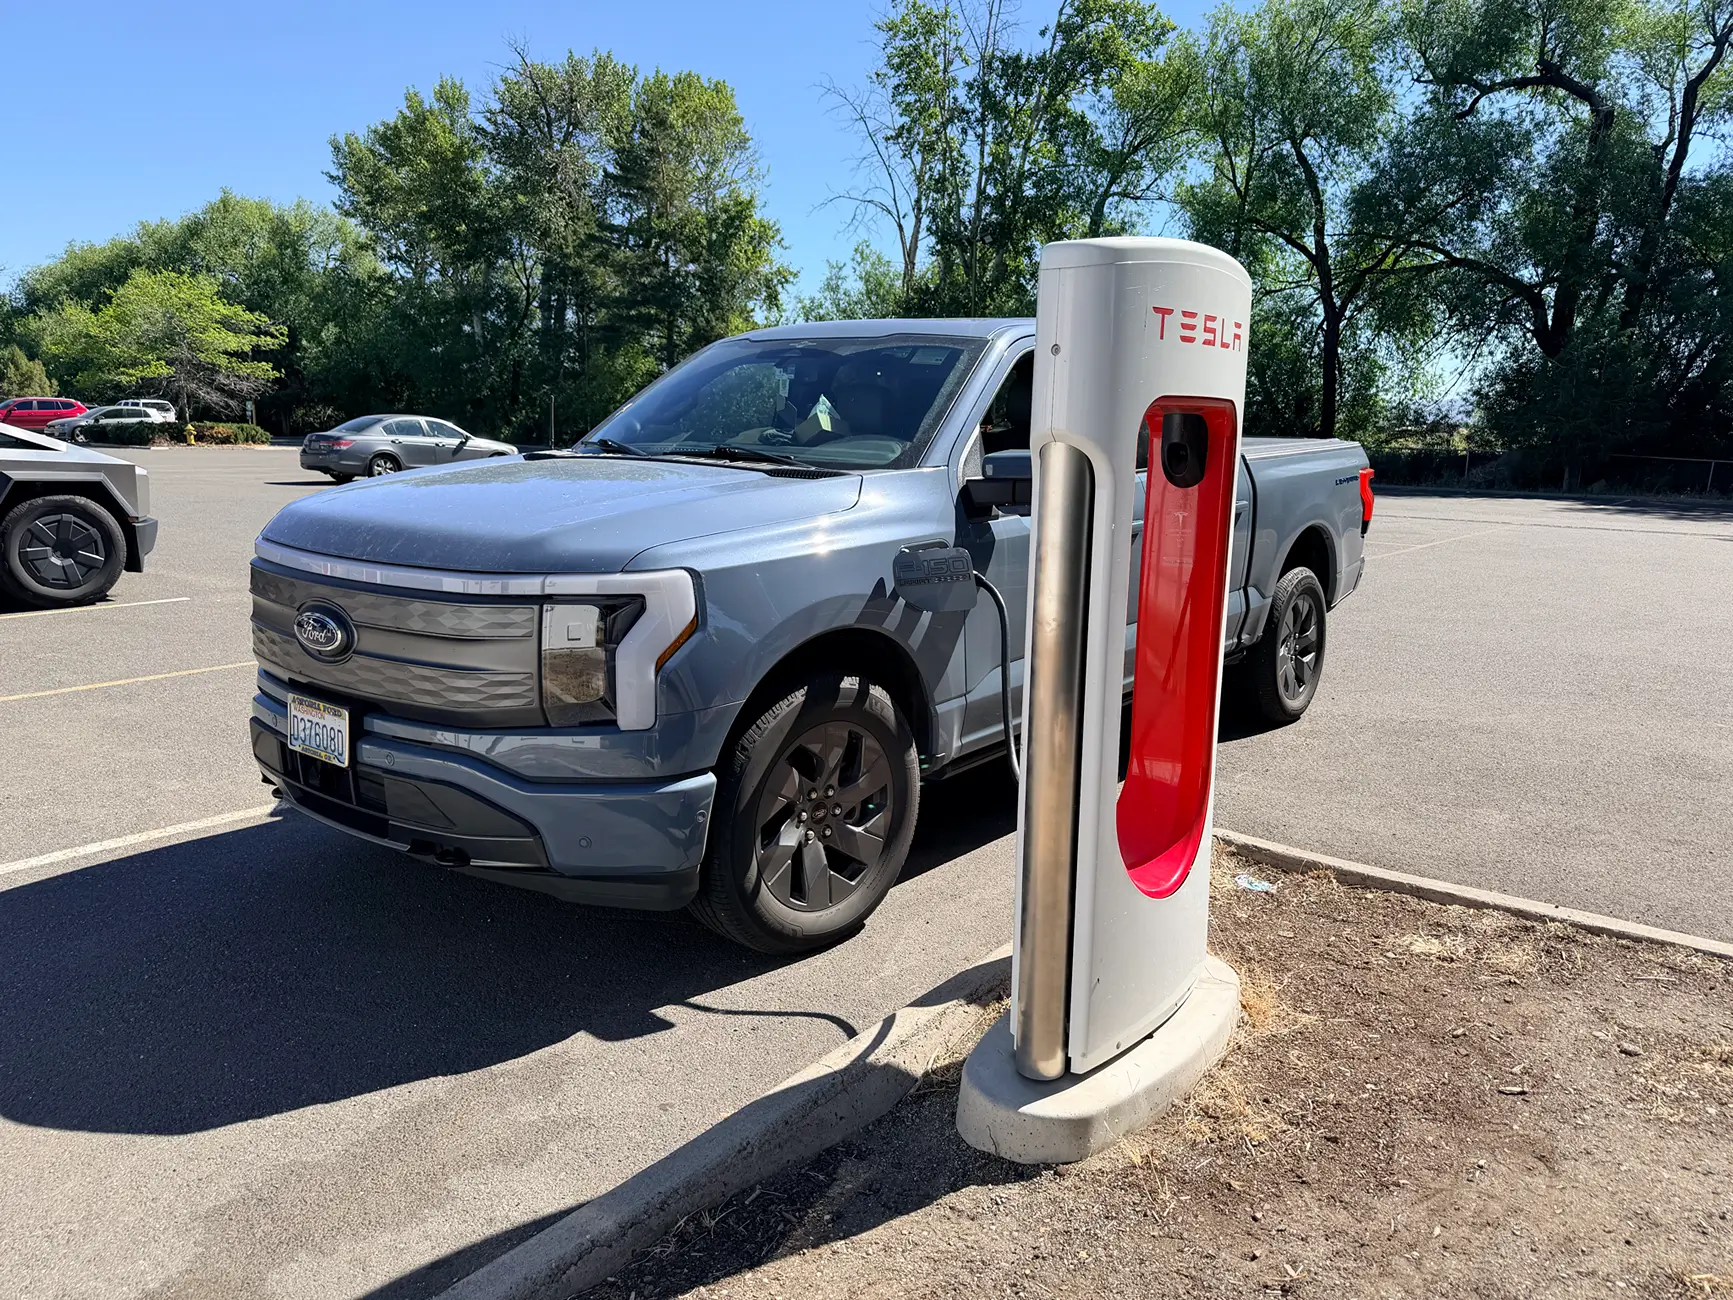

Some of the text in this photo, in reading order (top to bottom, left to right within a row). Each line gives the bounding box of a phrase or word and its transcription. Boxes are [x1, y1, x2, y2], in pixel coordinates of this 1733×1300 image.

[1152, 306, 1242, 352] TESLA
[896, 556, 970, 579] F-150
[299, 617, 328, 643] Ford
[292, 714, 344, 757] D37608D
